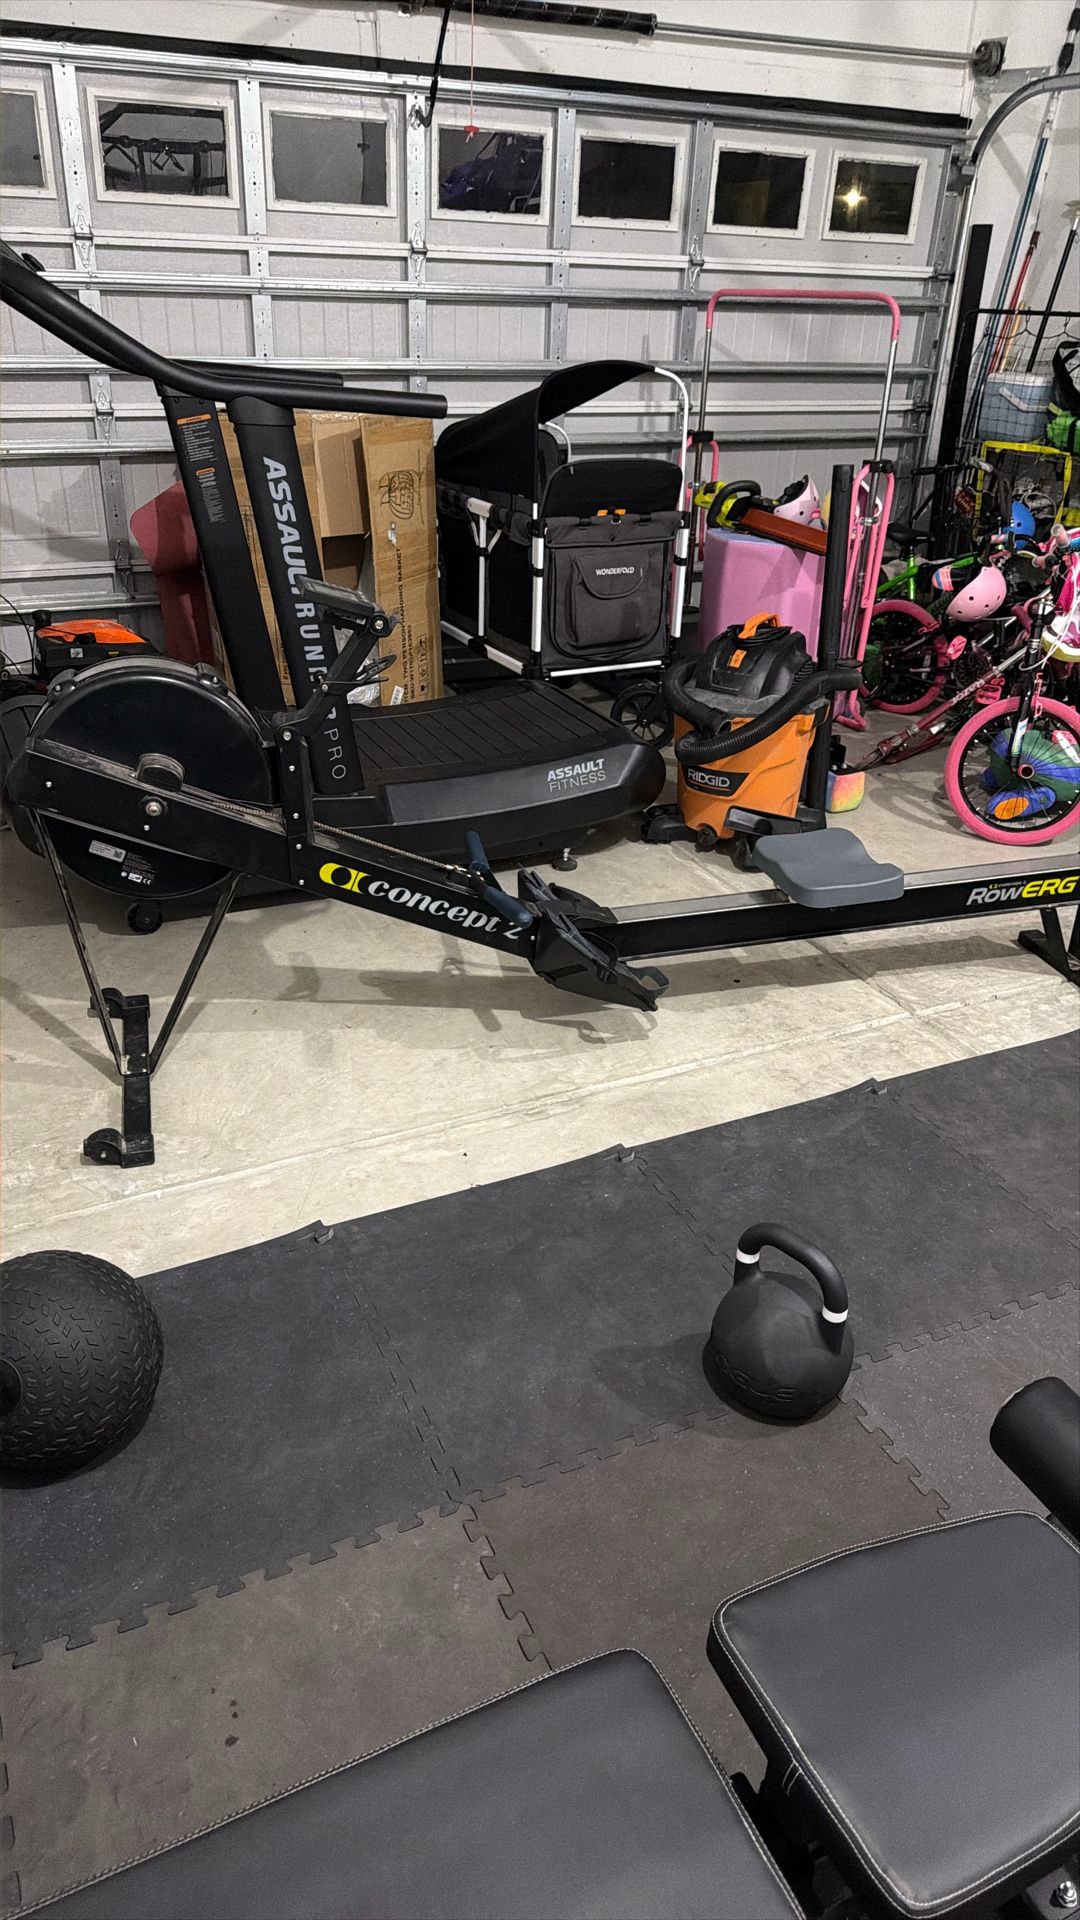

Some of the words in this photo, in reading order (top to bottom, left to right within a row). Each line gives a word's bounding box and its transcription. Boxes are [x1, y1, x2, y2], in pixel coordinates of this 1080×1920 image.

[595, 566, 635, 576] WONDERFOLD
[263, 456, 308, 594] ASSAUL
[324, 728, 347, 779] PRO
[547, 758, 605, 782] ASSAULT
[549, 770, 607, 793] FITNESS
[687, 768, 731, 788] RIDGID
[367, 880, 502, 933] concept
